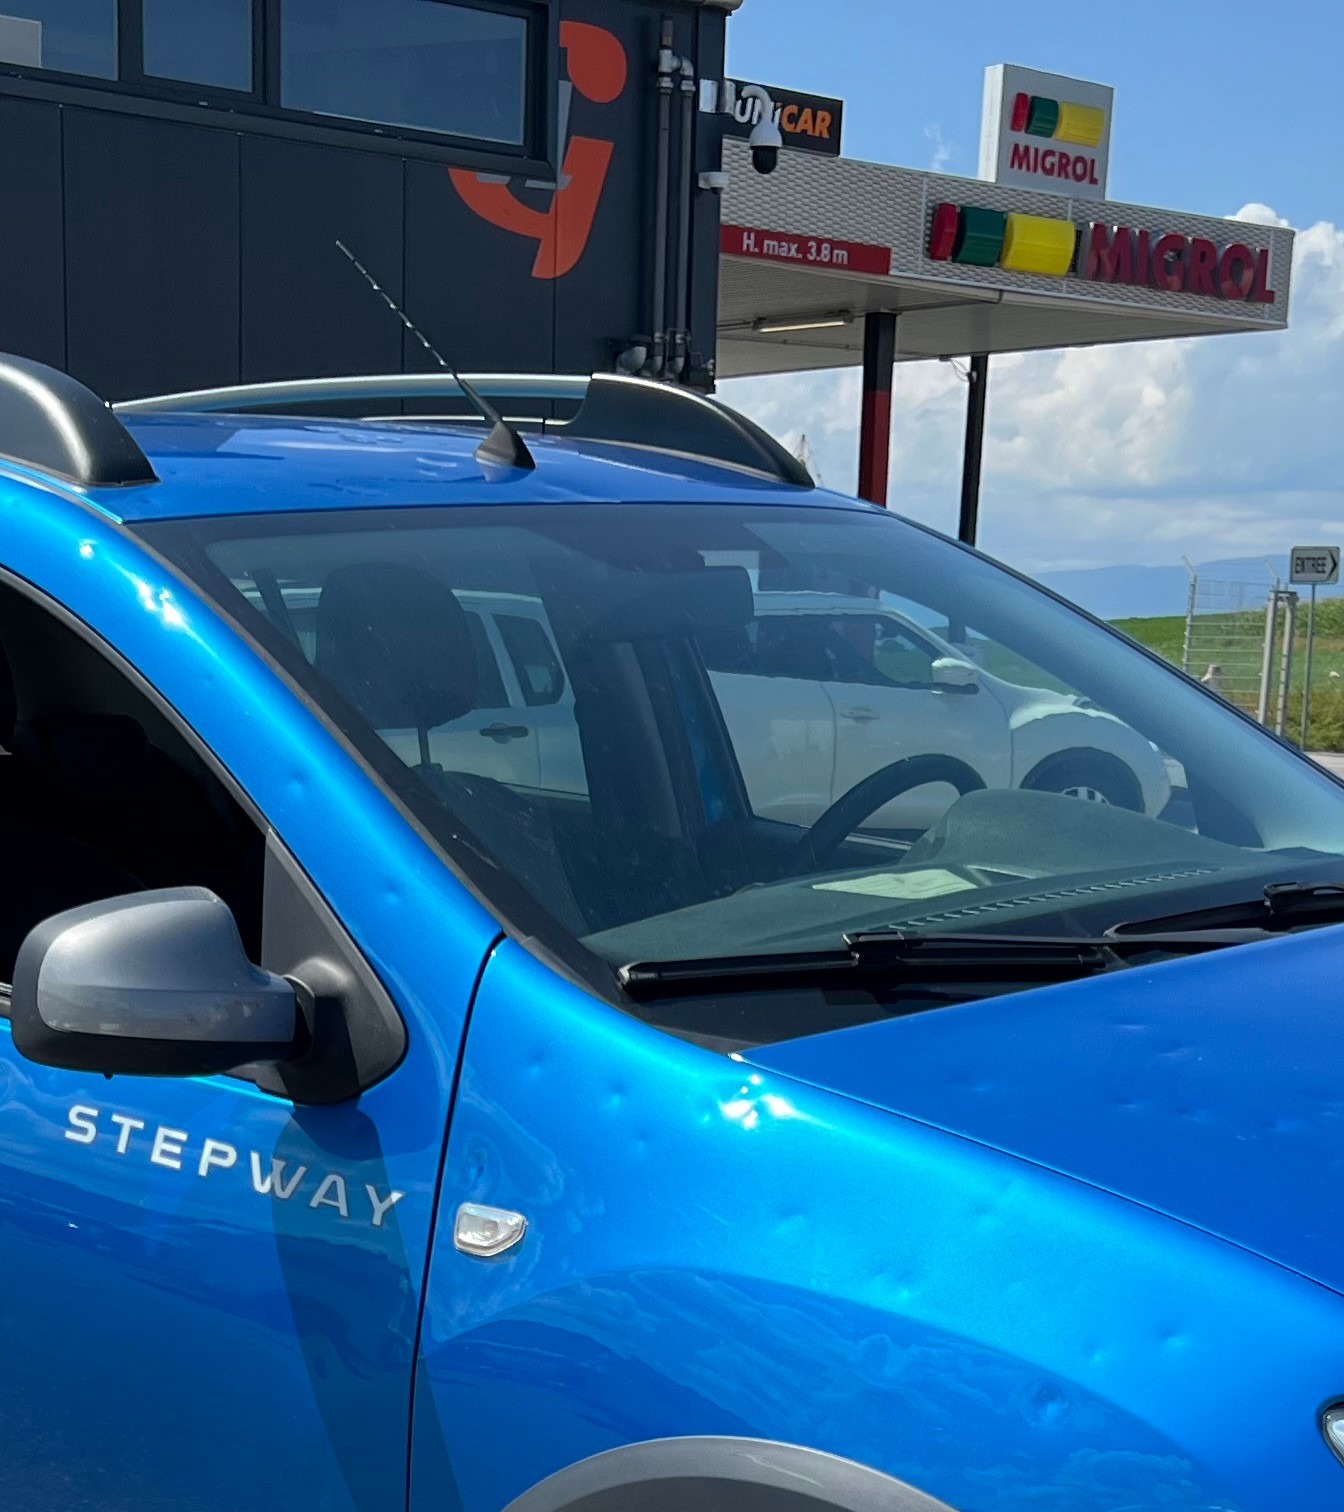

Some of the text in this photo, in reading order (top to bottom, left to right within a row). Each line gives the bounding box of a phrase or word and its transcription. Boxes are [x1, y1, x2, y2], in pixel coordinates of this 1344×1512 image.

[1010, 143, 1099, 186] MIGROL
[742, 231, 759, 253] H.
[763, 239, 803, 259] max.
[1085, 220, 1275, 304] MIGROL
[64, 1104, 406, 1227] STEPWAY
